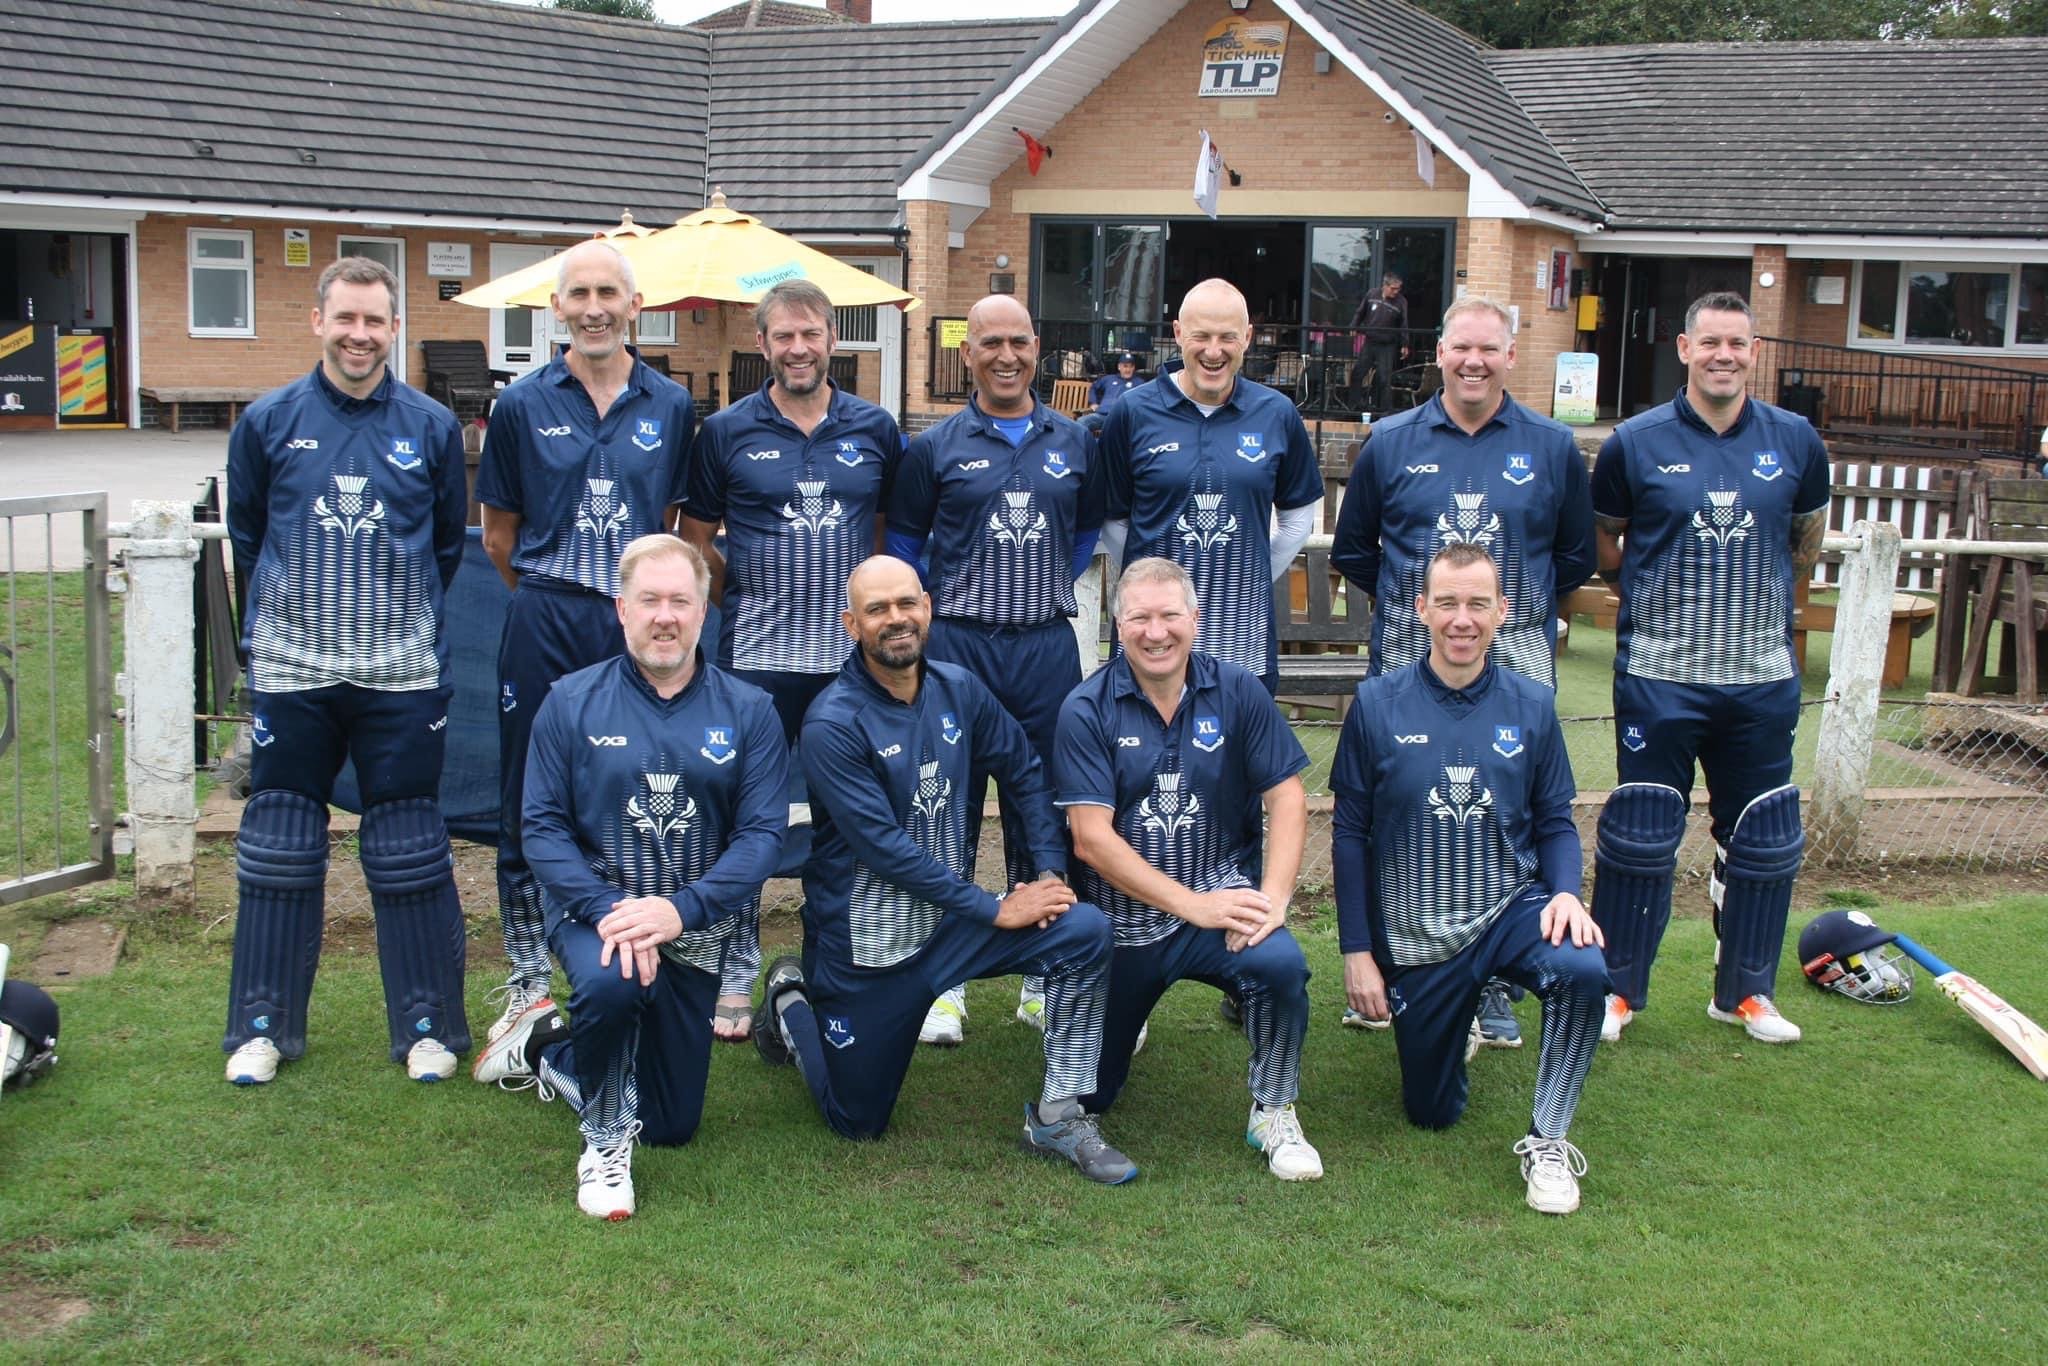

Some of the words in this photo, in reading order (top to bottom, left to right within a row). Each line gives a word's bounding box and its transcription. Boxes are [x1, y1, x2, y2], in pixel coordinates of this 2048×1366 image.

[1207, 50, 1280, 61] TICKHILL
[1206, 63, 1279, 88] TLP
[741, 268, 799, 289] Schweppes
[640, 421, 658, 435] XL
[394, 441, 414, 454] XL
[840, 442, 857, 452] XL
[1242, 436, 1260, 447] XL
[1048, 453, 1064, 465] XL
[1510, 457, 1529, 469] XL
[1758, 454, 1777, 465] XL
[1198, 720, 1218, 734] XL
[1627, 726, 1642, 738] XL
[709, 731, 729, 745] XL
[1498, 729, 1517, 741] XL
[829, 1018, 847, 1032] XL
